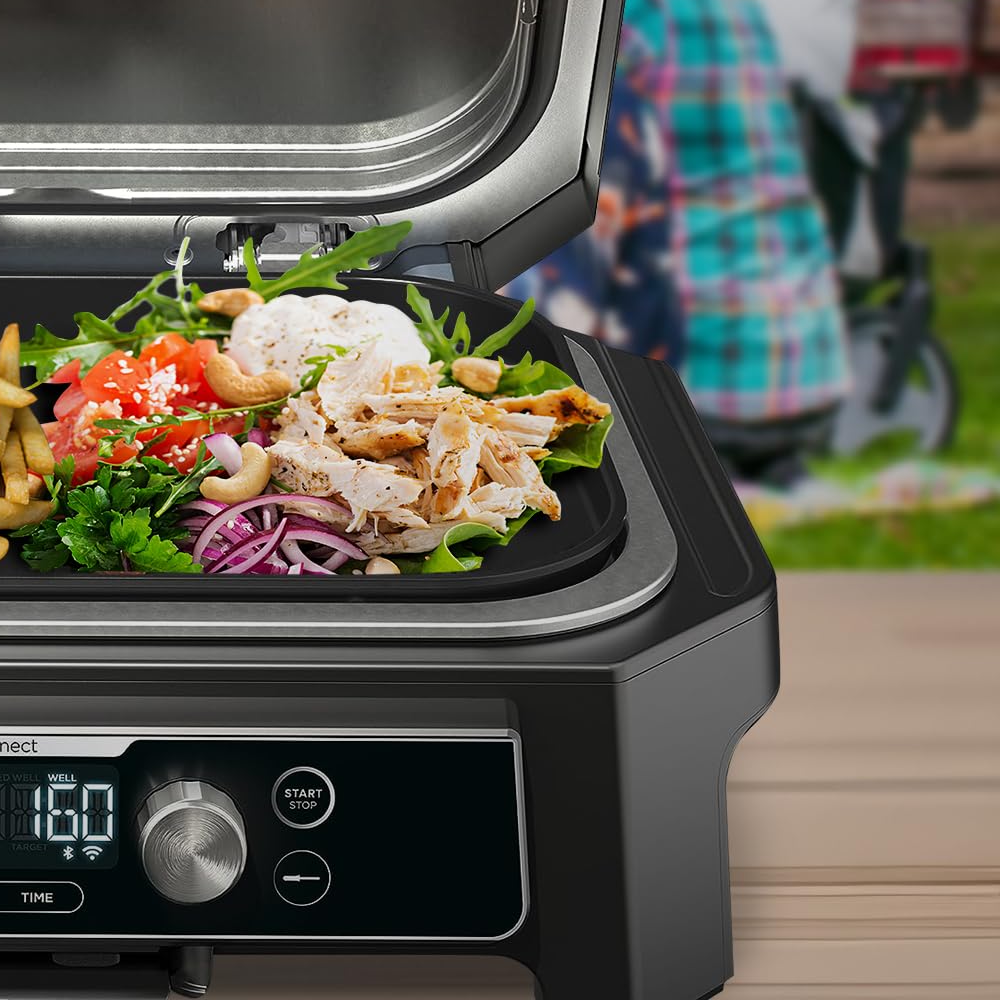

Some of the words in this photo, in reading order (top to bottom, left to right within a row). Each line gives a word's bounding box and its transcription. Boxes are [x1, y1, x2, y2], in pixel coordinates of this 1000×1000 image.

[47, 773, 78, 783] WELL
[284, 788, 323, 799] START
[289, 800, 318, 810] STOP
[33, 783, 114, 842] 160
[21, 892, 54, 903] TIME
